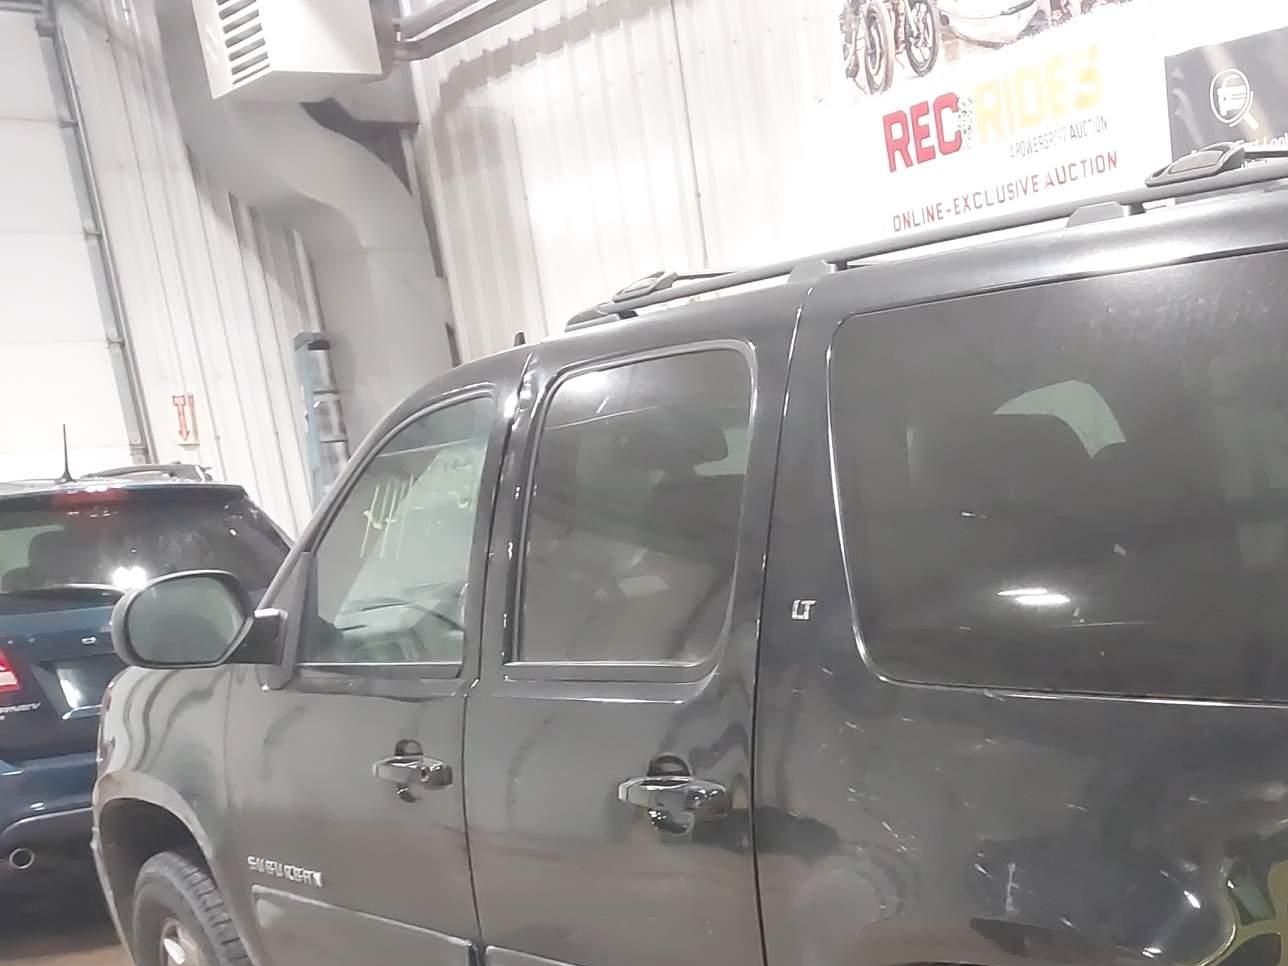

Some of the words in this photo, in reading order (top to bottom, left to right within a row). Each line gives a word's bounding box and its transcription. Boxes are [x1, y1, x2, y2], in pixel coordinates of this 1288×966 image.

[882, 92, 963, 173] REC
[893, 174, 1040, 232] ONLINE-EXCLUSIVE
[1044, 150, 1118, 190] AUCTION
[792, 599, 816, 620] LT
